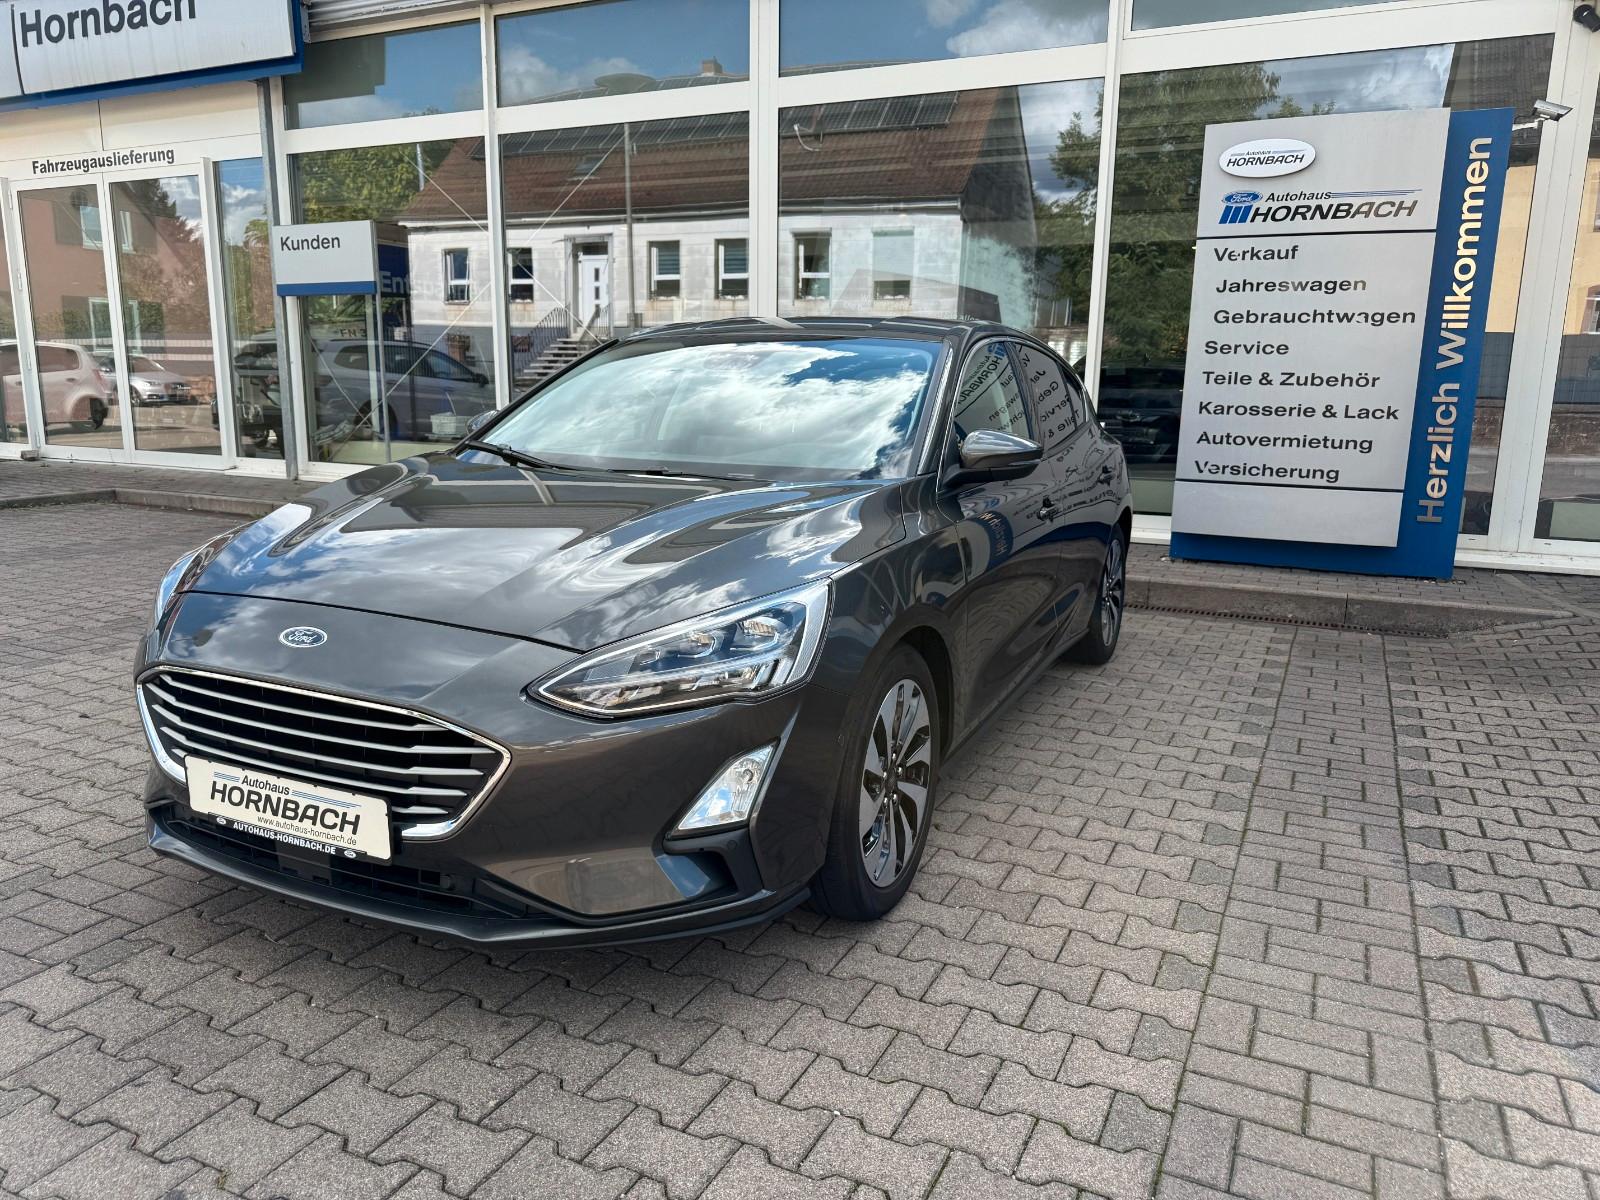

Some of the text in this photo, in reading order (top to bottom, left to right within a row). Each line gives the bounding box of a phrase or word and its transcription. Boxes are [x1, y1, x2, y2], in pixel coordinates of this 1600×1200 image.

[20, 0, 196, 47] Hornbach
[32, 148, 175, 175] Fahrzeugauslieferung
[1226, 154, 1305, 167] HORNBACH
[1265, 190, 1333, 203] Autohaus
[1250, 199, 1419, 223] HORNBACH
[280, 234, 341, 252] Kunden
[1213, 245, 1299, 262] Verkauf
[1215, 278, 1367, 295] Jahreswagen
[1213, 309, 1416, 328] Gebrauchtwagen
[1416, 137, 1493, 523] Herzlich Willkommen
[1204, 340, 1290, 356] Service
[1202, 371, 1381, 388] Teile & Zubehör
[1198, 401, 1400, 421] Karosserie & Lack
[1196, 431, 1374, 454] Autovermietung
[1195, 460, 1340, 484] Versicherung
[241, 774, 290, 796] Autohaus
[210, 780, 361, 836] HORNBACH
[233, 821, 337, 856] AUTOHAUS-HORNBACH.DE
[257, 814, 357, 846] www.autohaus-hornbach.de
